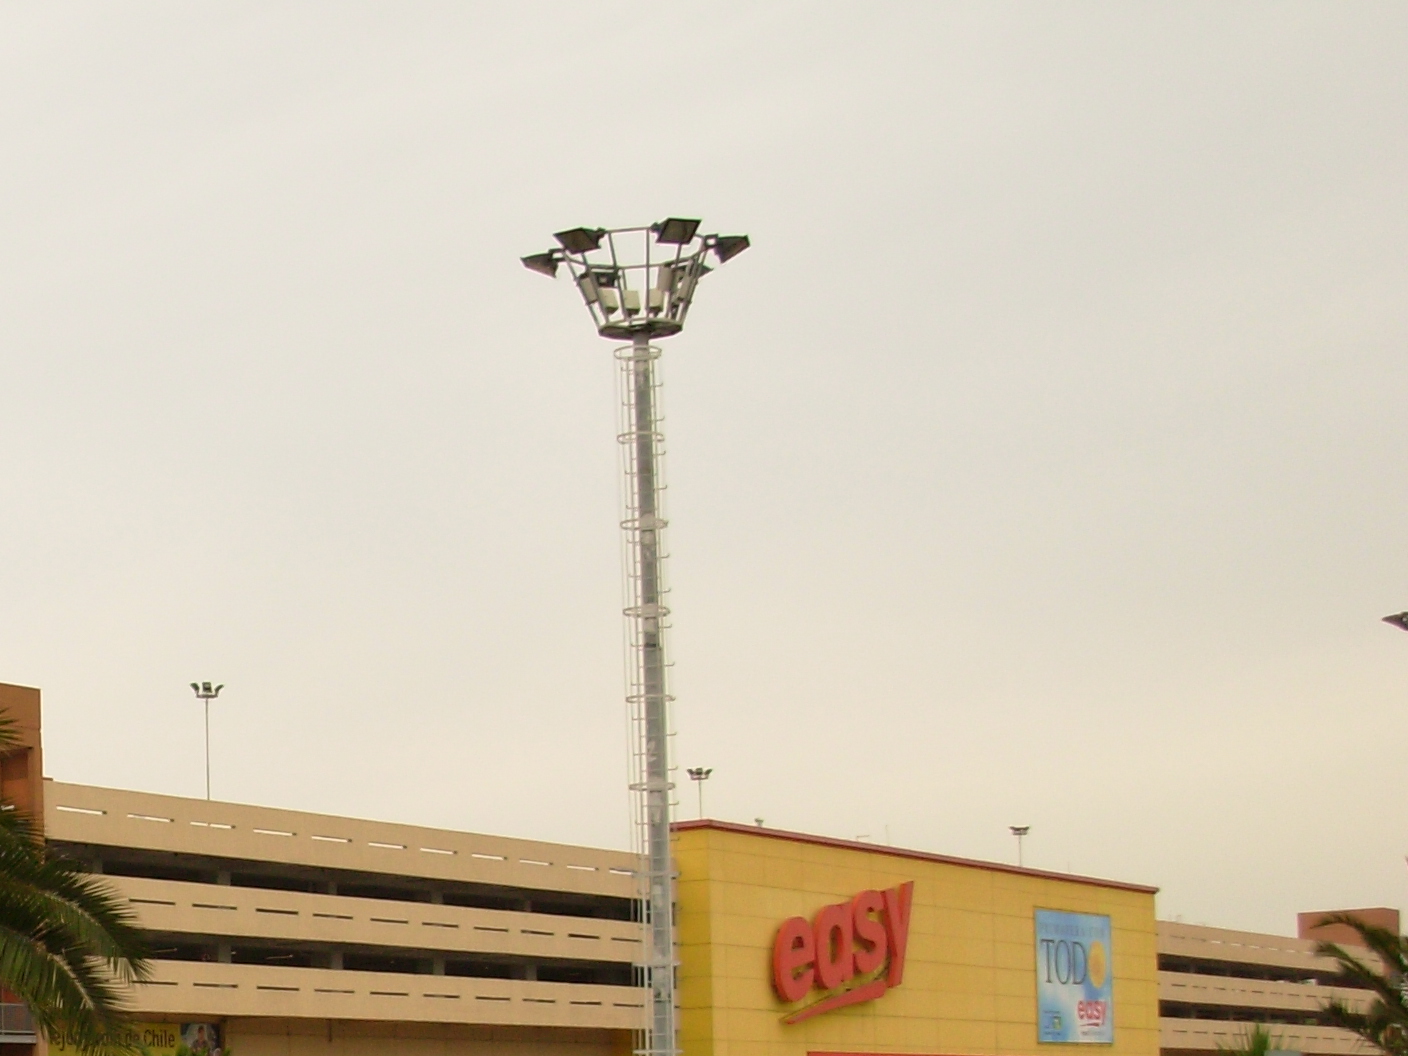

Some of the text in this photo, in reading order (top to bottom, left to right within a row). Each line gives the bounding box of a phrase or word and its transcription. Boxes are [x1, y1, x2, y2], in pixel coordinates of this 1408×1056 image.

[771, 880, 914, 1003] easy
[1077, 1000, 1106, 1026] easy
[143, 1028, 176, 1049] Chile
